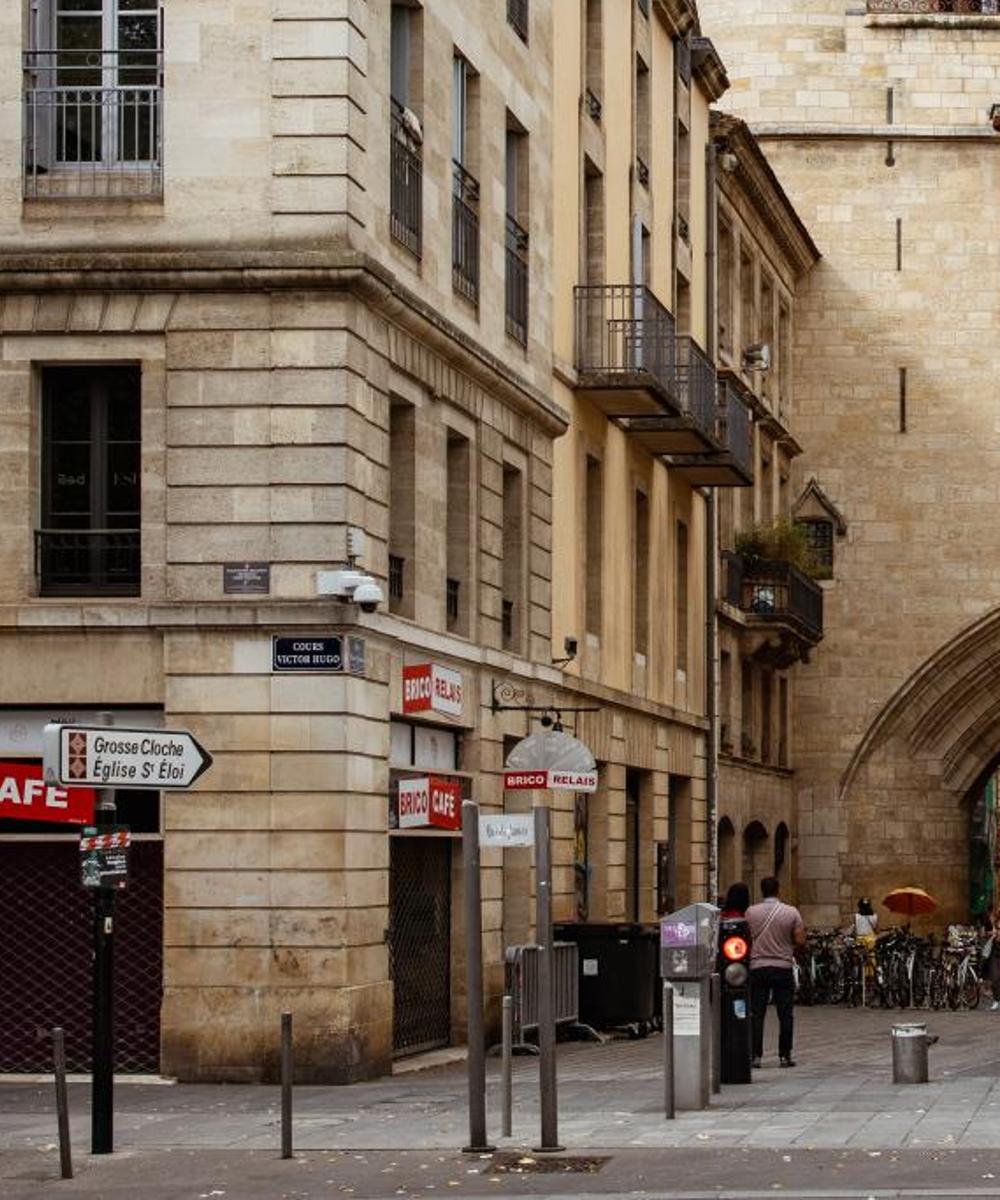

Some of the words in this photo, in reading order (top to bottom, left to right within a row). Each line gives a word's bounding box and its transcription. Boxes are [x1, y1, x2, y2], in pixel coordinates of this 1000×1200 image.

[277, 654, 311, 664] VICTOR
[312, 654, 341, 664] HUGO
[405, 676, 432, 701] BRICO
[435, 677, 461, 704] RELAIS
[94, 736, 138, 755] Grosse
[140, 738, 184, 757] Cloche
[93, 756, 136, 781] Église
[158, 759, 185, 779] Éloi
[507, 775, 545, 787] BRICO
[553, 775, 596, 786] RELAIS
[400, 789, 428, 816] BRICO
